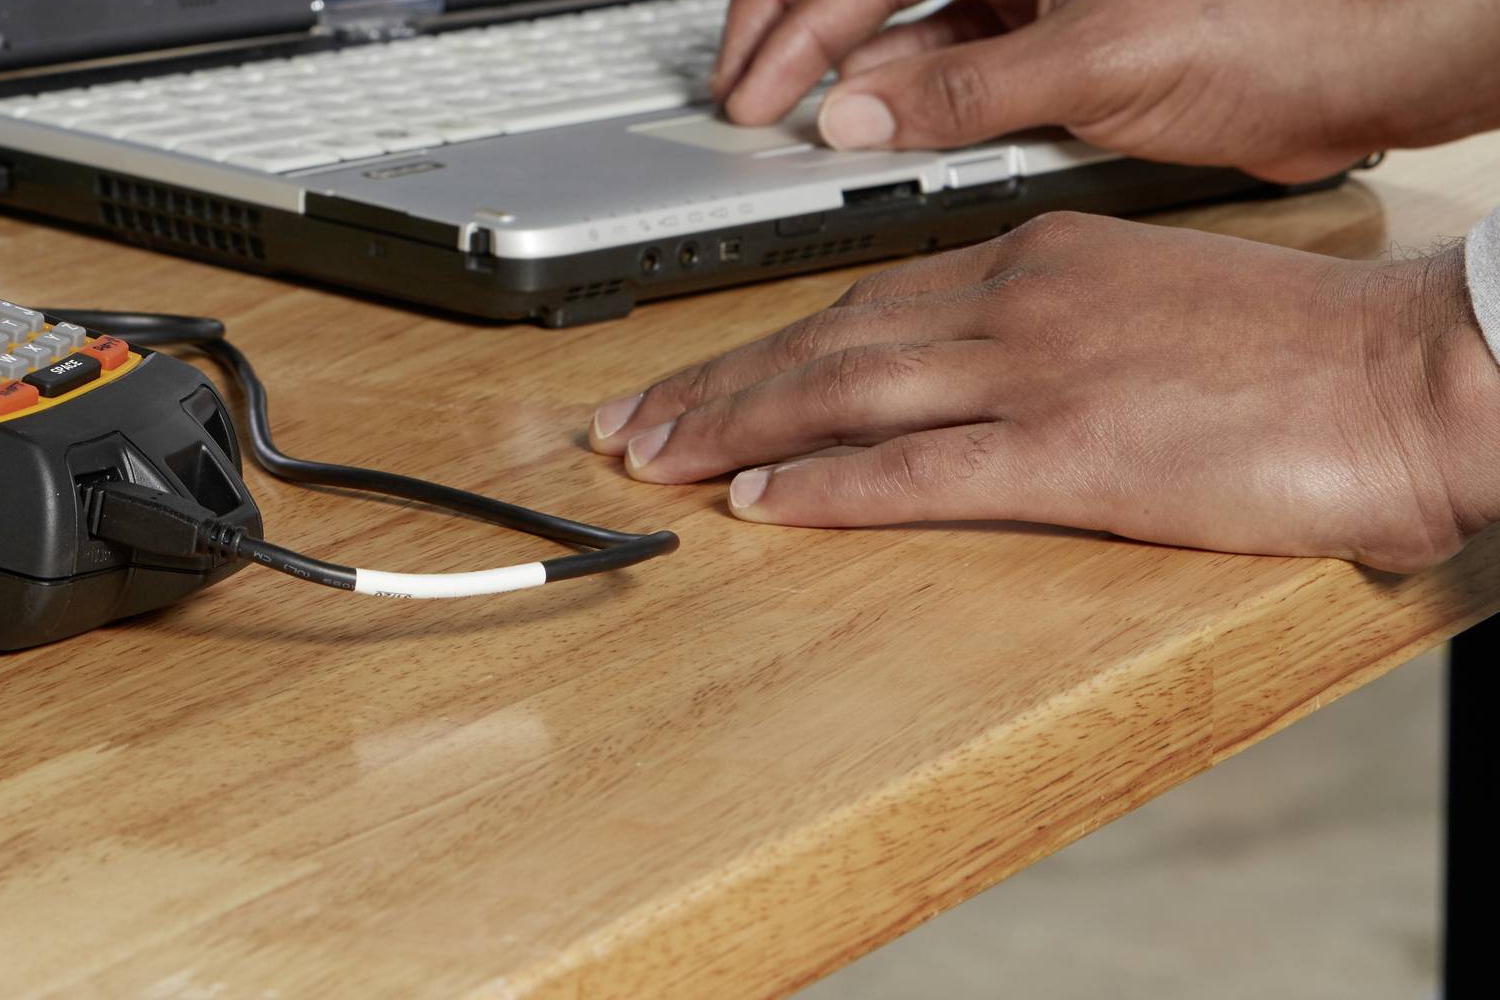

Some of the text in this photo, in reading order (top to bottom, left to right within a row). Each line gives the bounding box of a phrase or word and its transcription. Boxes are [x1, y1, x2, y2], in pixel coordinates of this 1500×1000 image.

[44, 333, 60, 341] Y
[23, 344, 42, 352] X
[50, 359, 83, 375] SPACE
